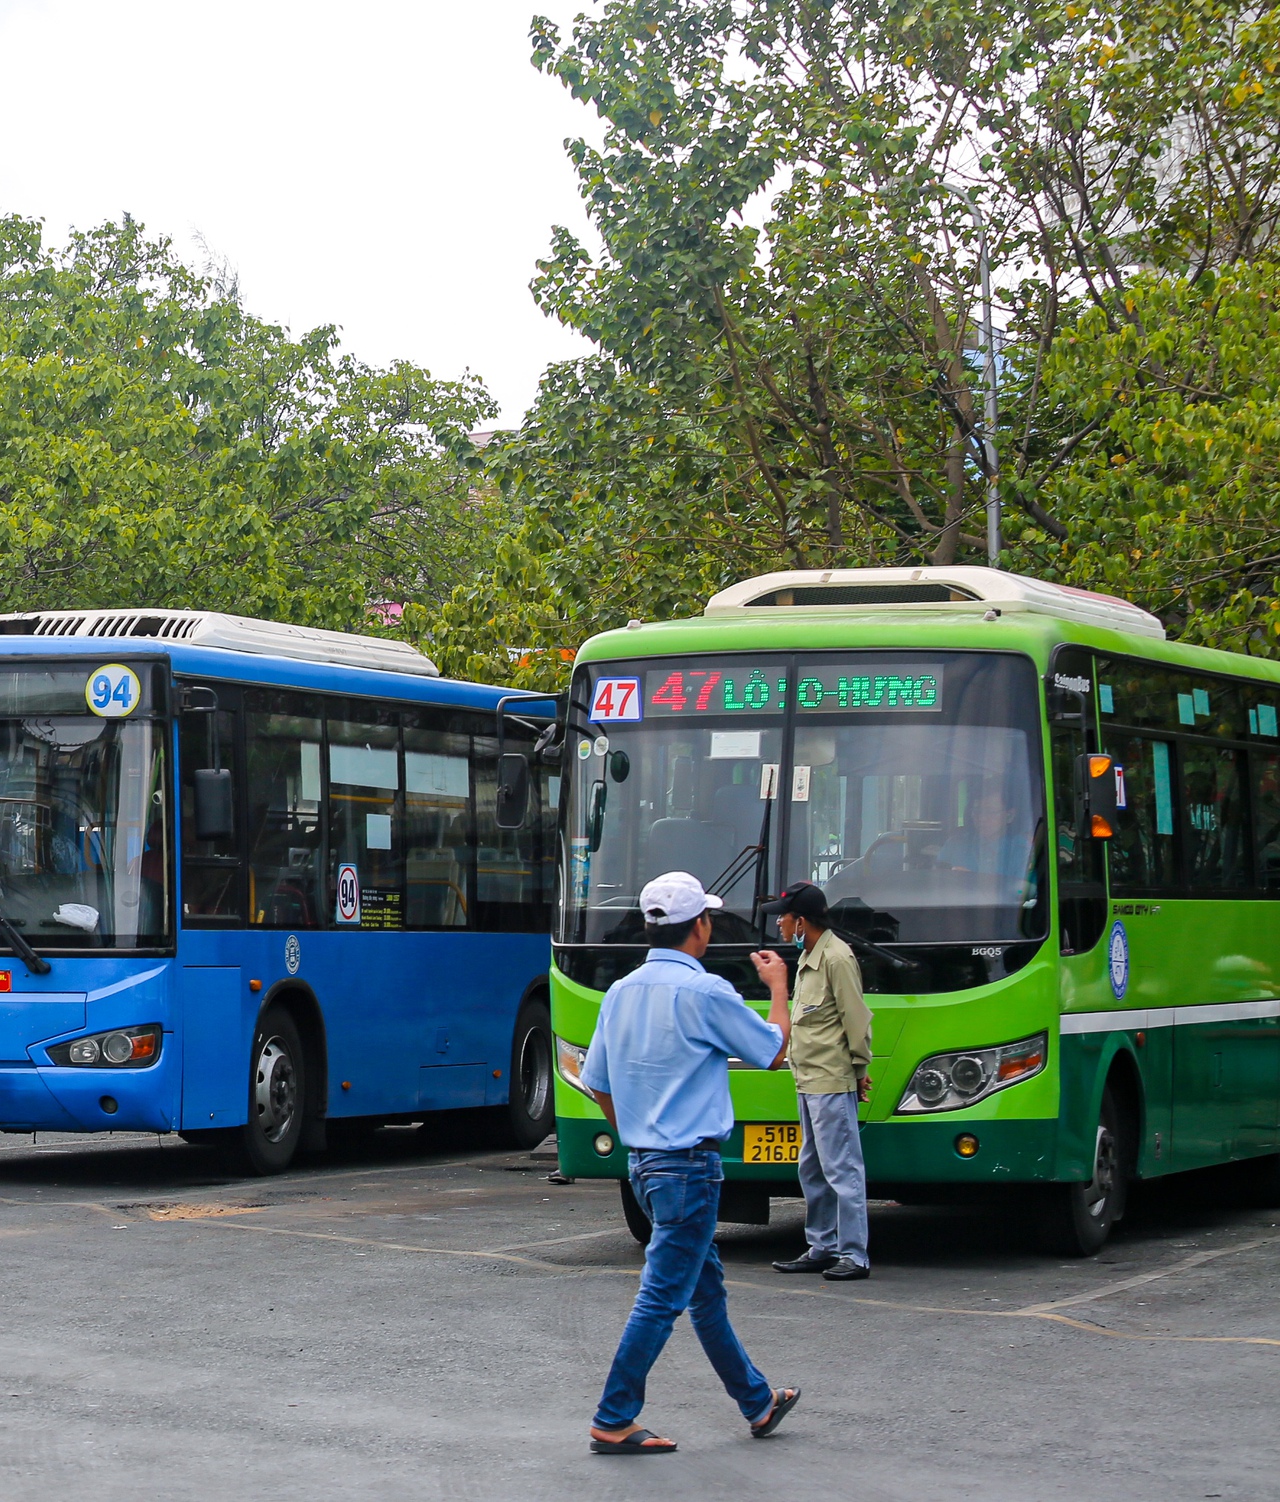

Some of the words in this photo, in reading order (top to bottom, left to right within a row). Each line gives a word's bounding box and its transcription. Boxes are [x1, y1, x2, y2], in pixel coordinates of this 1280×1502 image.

[93, 675, 132, 709] 94
[595, 683, 635, 717] 47
[651, 672, 722, 711] 47
[341, 879, 356, 908] 94
[765, 1126, 797, 1143] 51B
[751, 1145, 799, 1161] 216.0
